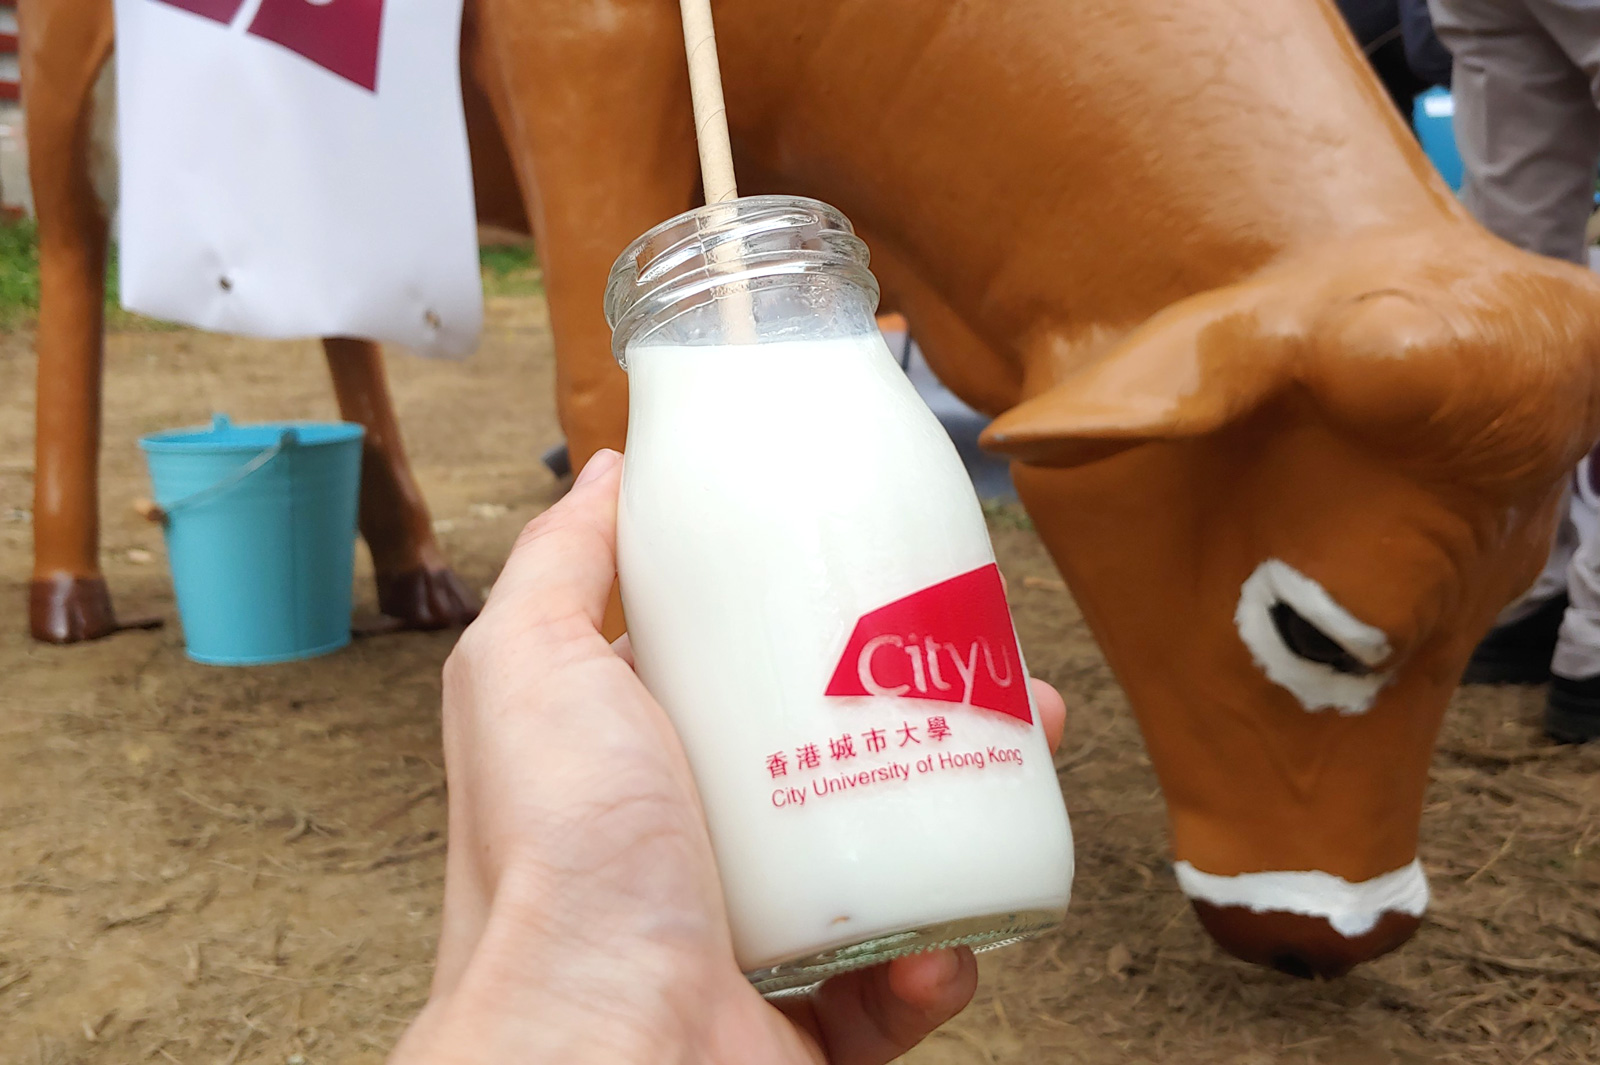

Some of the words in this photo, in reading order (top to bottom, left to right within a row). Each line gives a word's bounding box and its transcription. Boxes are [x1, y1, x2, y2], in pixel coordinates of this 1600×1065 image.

[857, 633, 1012, 704] CityU
[765, 715, 952, 779] 香港城市大學
[771, 786, 806, 808] City
[813, 760, 910, 797] University
[917, 755, 935, 774] of
[939, 750, 985, 769] Hong
[987, 746, 1023, 765] Kong
